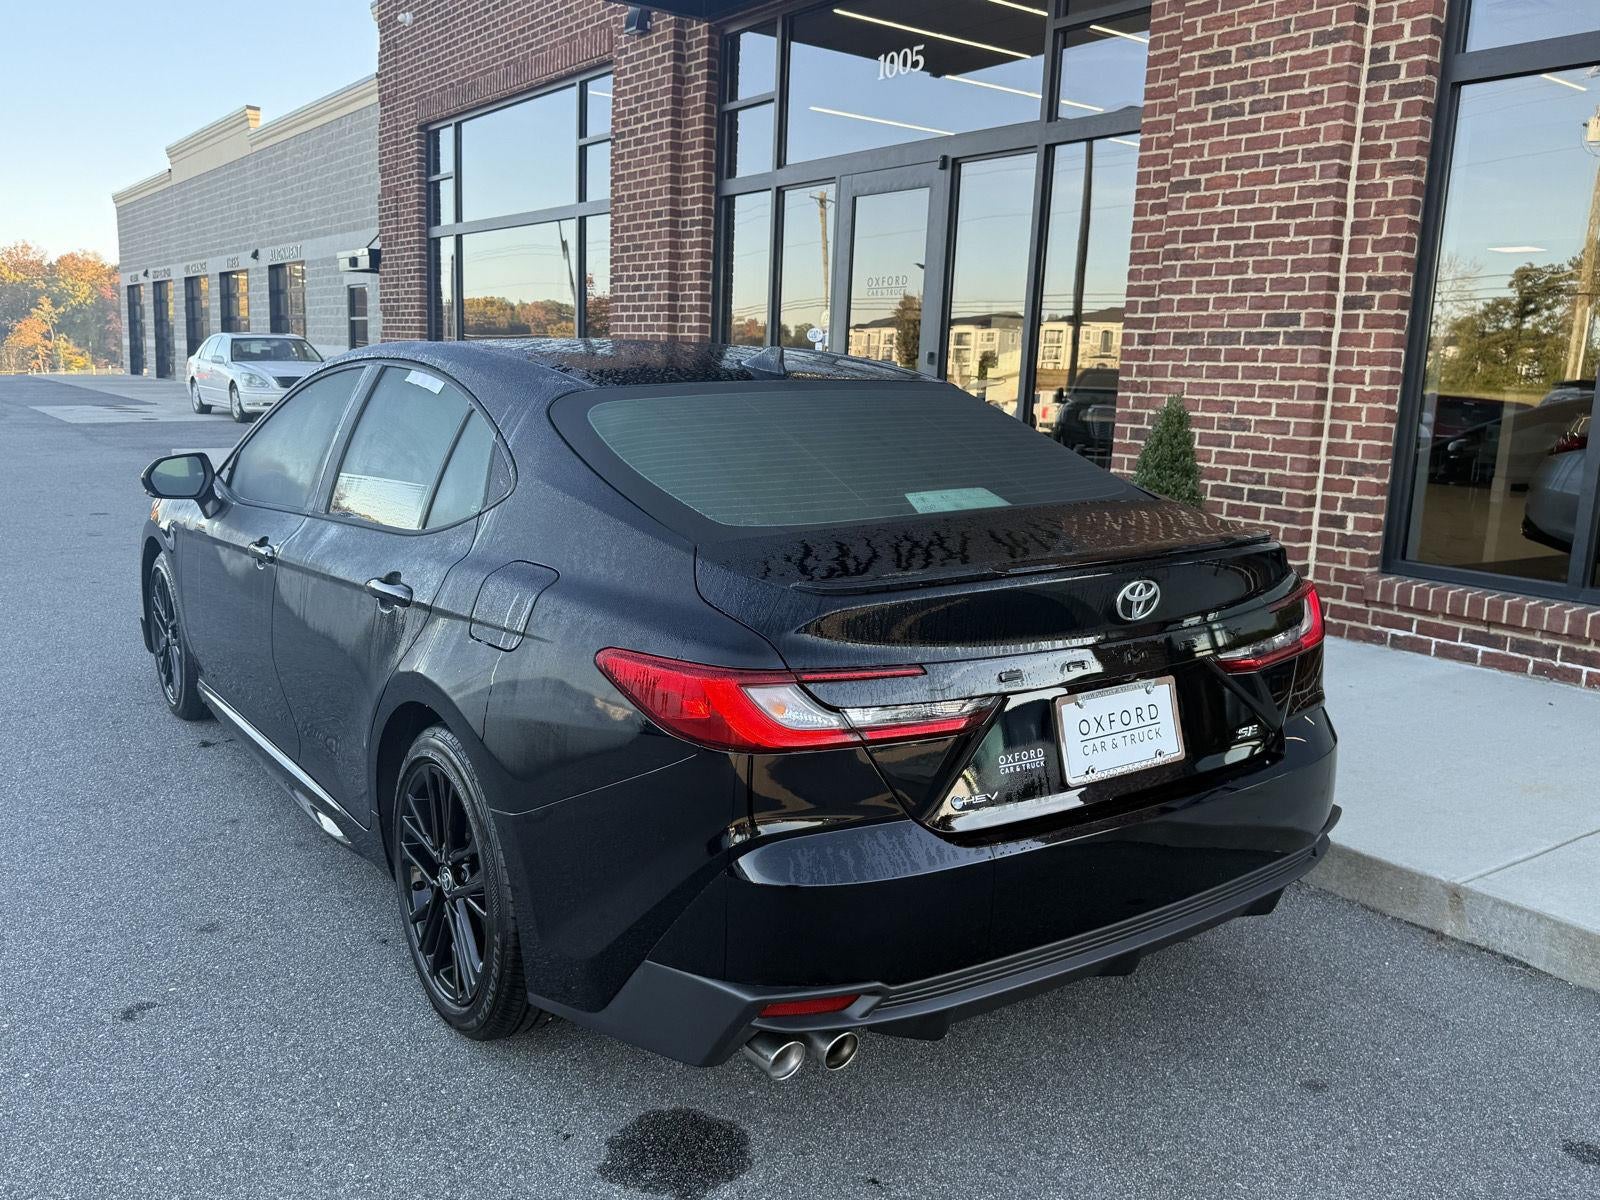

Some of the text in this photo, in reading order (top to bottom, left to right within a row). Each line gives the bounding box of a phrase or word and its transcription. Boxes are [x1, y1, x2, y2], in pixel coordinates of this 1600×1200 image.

[877, 44, 925, 80] 1005
[867, 275, 908, 287] OXFORD
[1078, 703, 1159, 736] OXFORD
[1082, 727, 1163, 756] CAR & TRUCK
[998, 748, 1045, 765] OXFORD
[1000, 766, 1015, 775] CAR
[1022, 760, 1046, 770] TRUCK
[479, 932, 501, 1020] TURANZA
